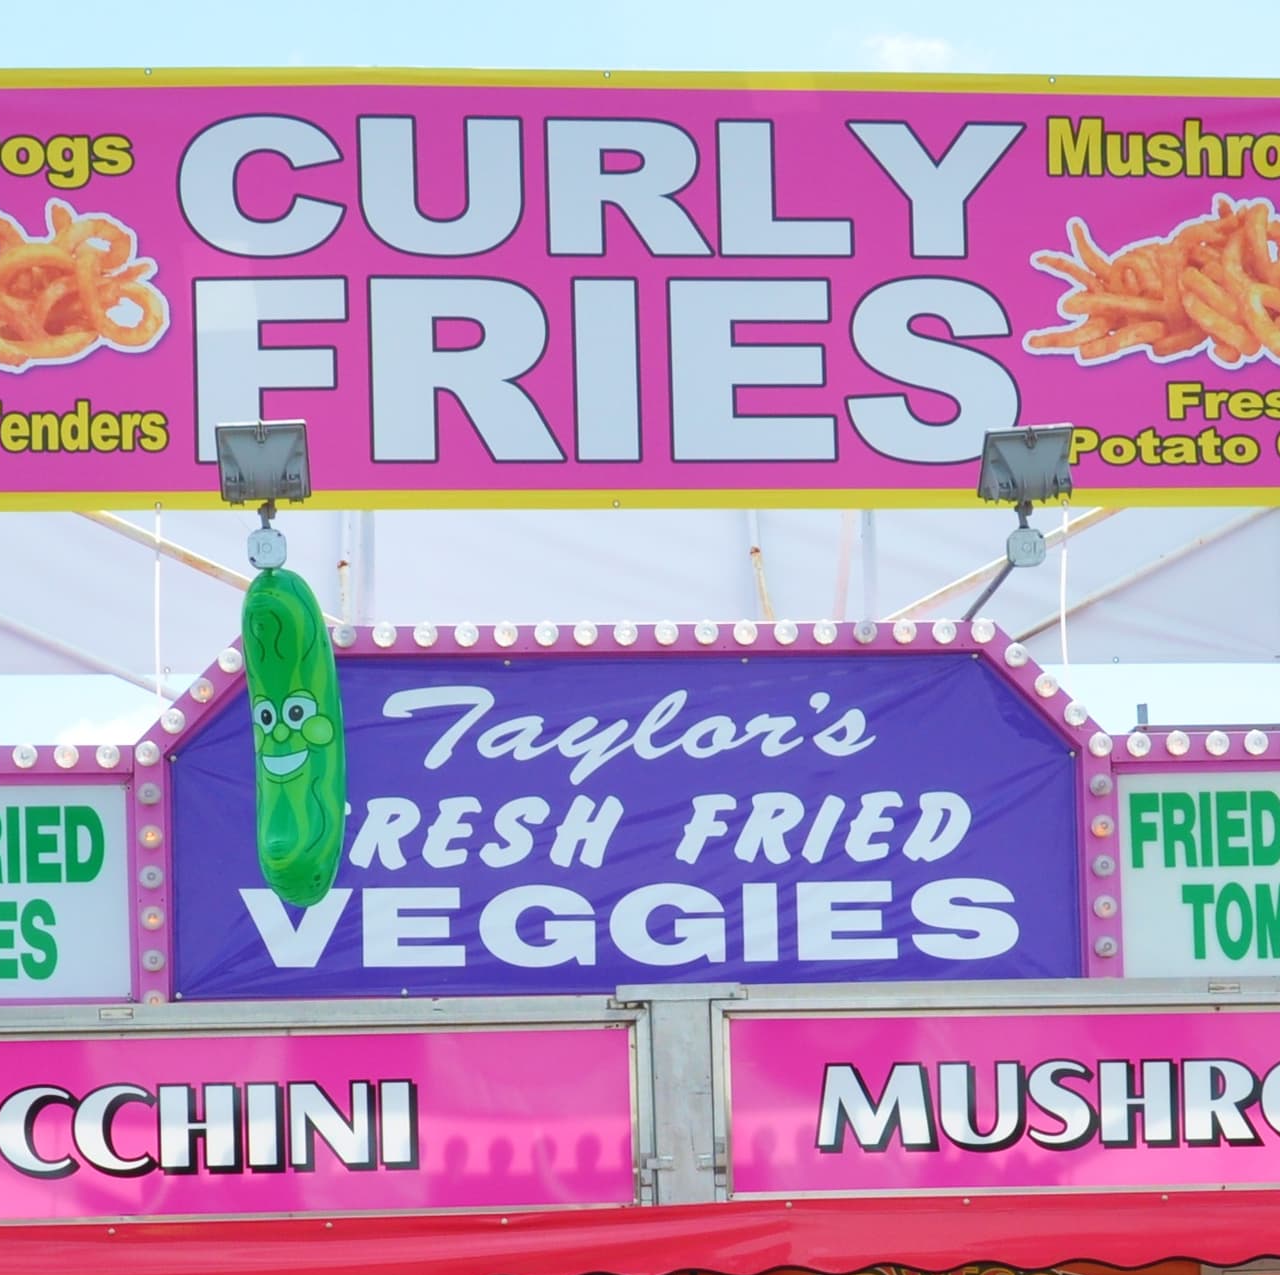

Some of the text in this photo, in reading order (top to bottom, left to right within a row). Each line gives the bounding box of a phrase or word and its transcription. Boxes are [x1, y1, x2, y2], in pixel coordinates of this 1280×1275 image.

[177, 113, 1026, 259] CURLY
[192, 274, 1021, 464] FRIES
[1068, 426, 1261, 466] Potato
[384, 684, 875, 786] Taylor's
[347, 789, 972, 869] RESH FRIED
[238, 877, 1020, 968] VEGGIES
